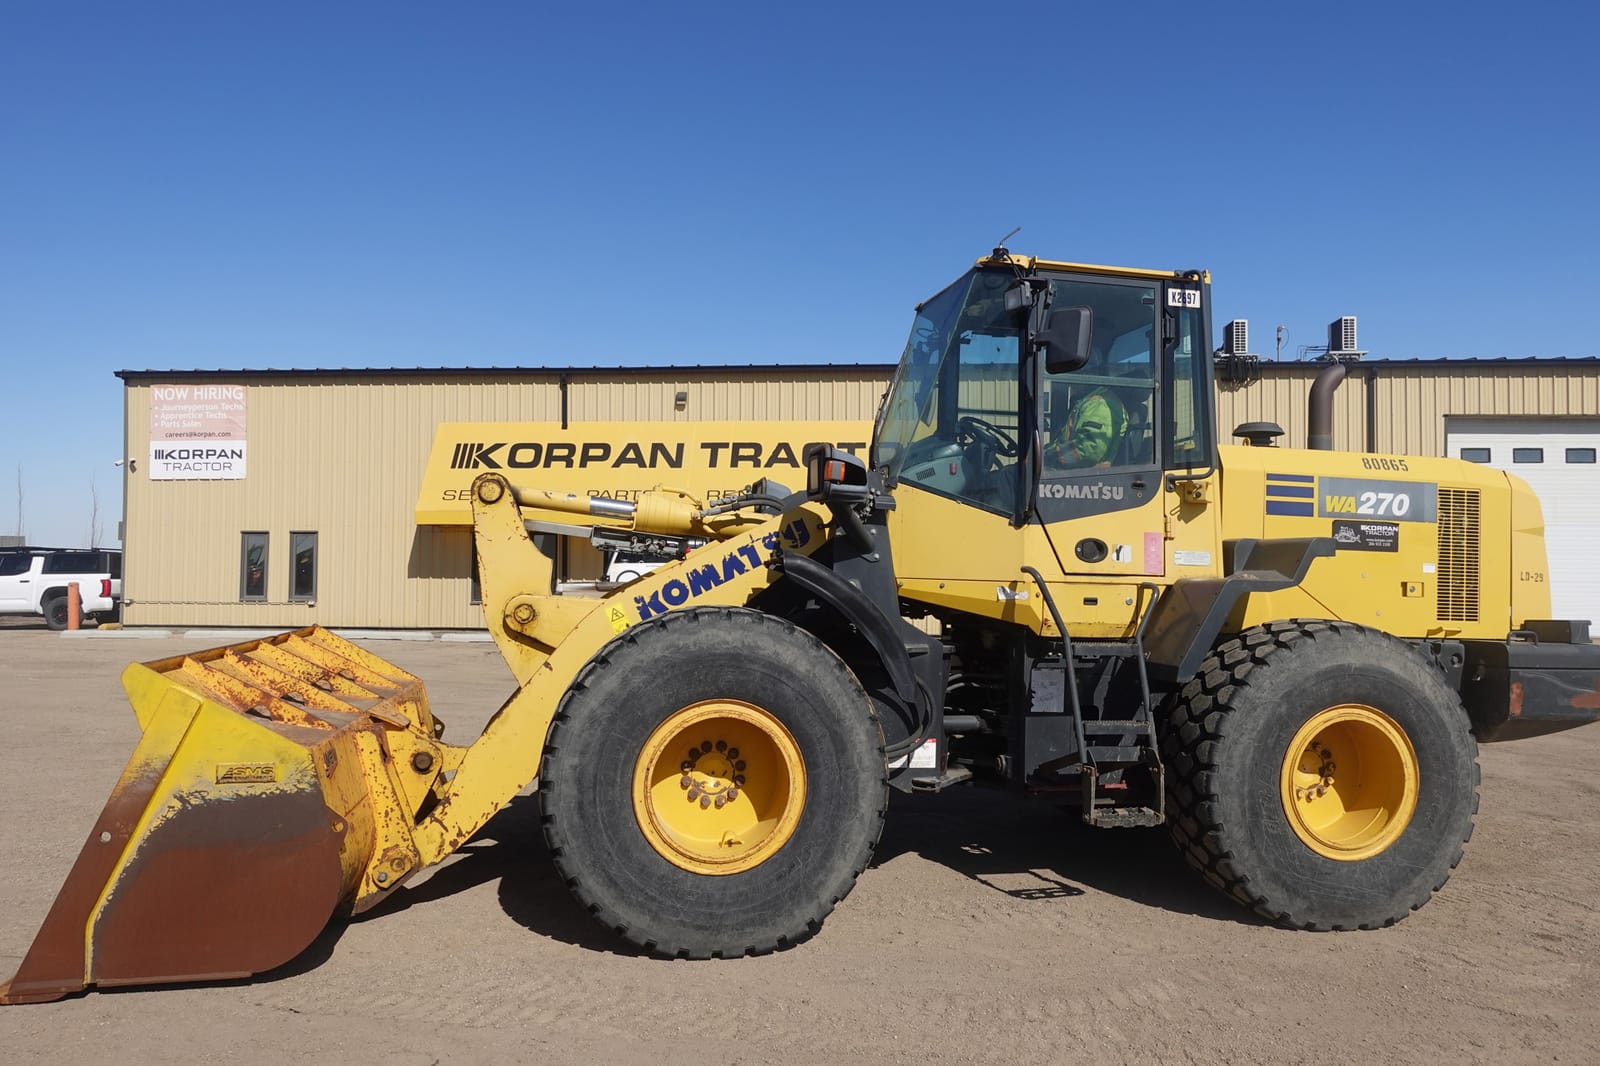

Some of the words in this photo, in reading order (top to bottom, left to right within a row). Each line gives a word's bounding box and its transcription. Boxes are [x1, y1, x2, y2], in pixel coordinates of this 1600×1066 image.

[154, 387, 188, 400] NOW
[193, 387, 243, 400] HIRING
[701, 442, 874, 469] TRAT
[163, 462, 233, 471] TRACTOR
[587, 489, 656, 501] PART
[1039, 482, 1124, 500] KOMATSU
